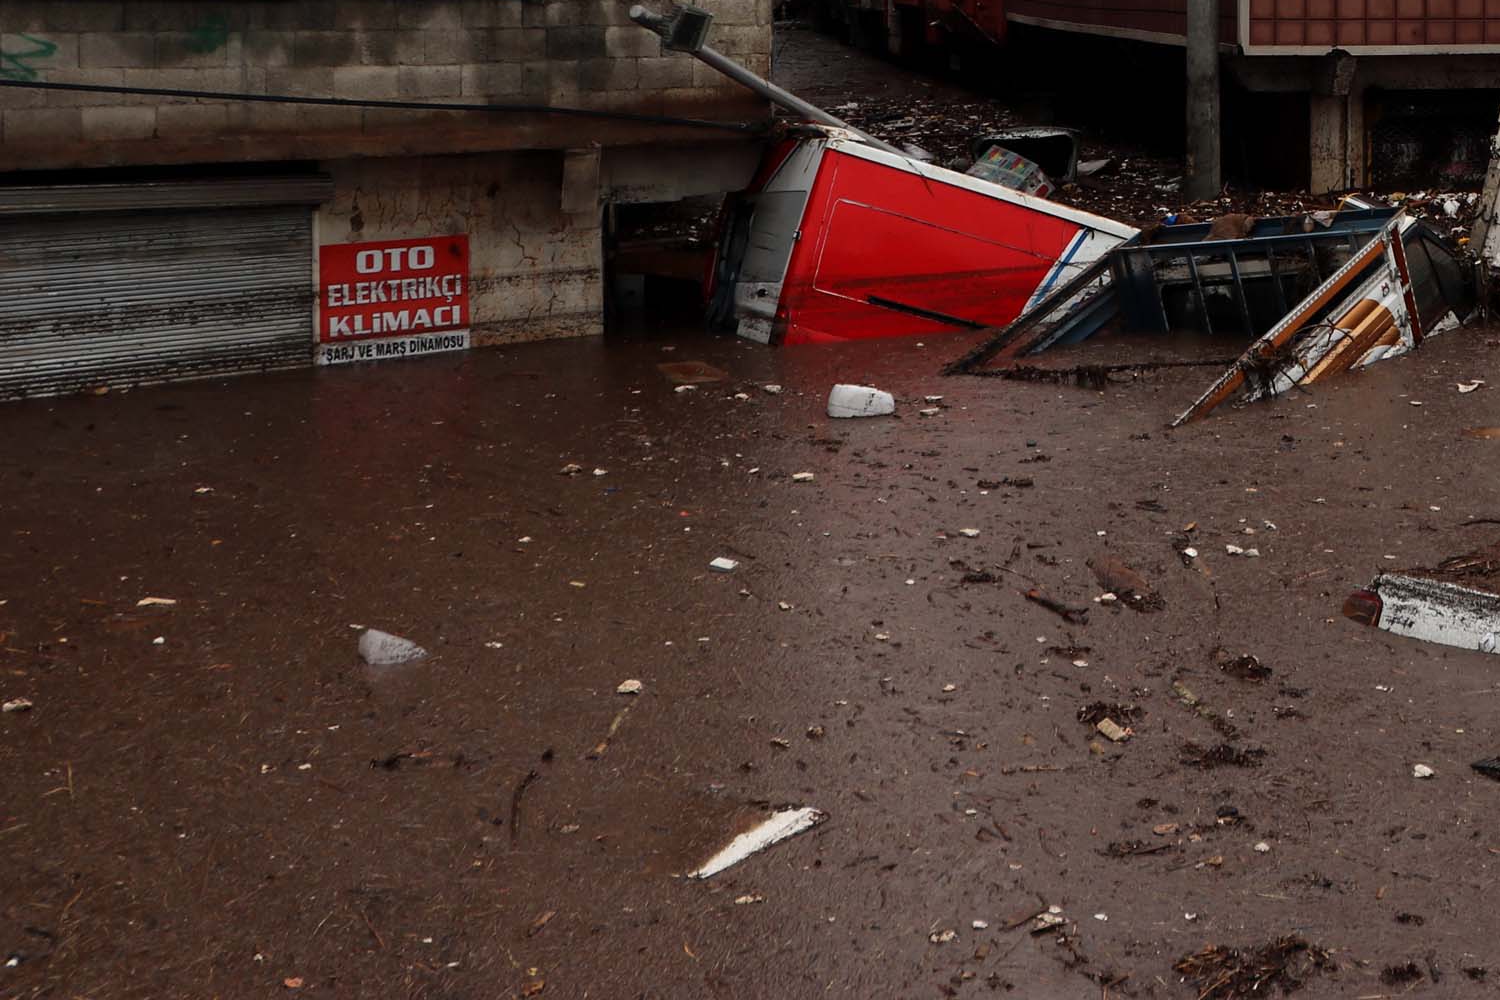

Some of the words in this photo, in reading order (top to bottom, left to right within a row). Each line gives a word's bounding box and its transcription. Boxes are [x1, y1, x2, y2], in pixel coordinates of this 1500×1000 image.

[355, 245, 435, 274] OTO
[327, 274, 462, 307] ELEKTRİKÇİ
[329, 305, 461, 337] KLİMACI
[358, 345, 373, 358] VE
[376, 341, 406, 357] MARŞ
